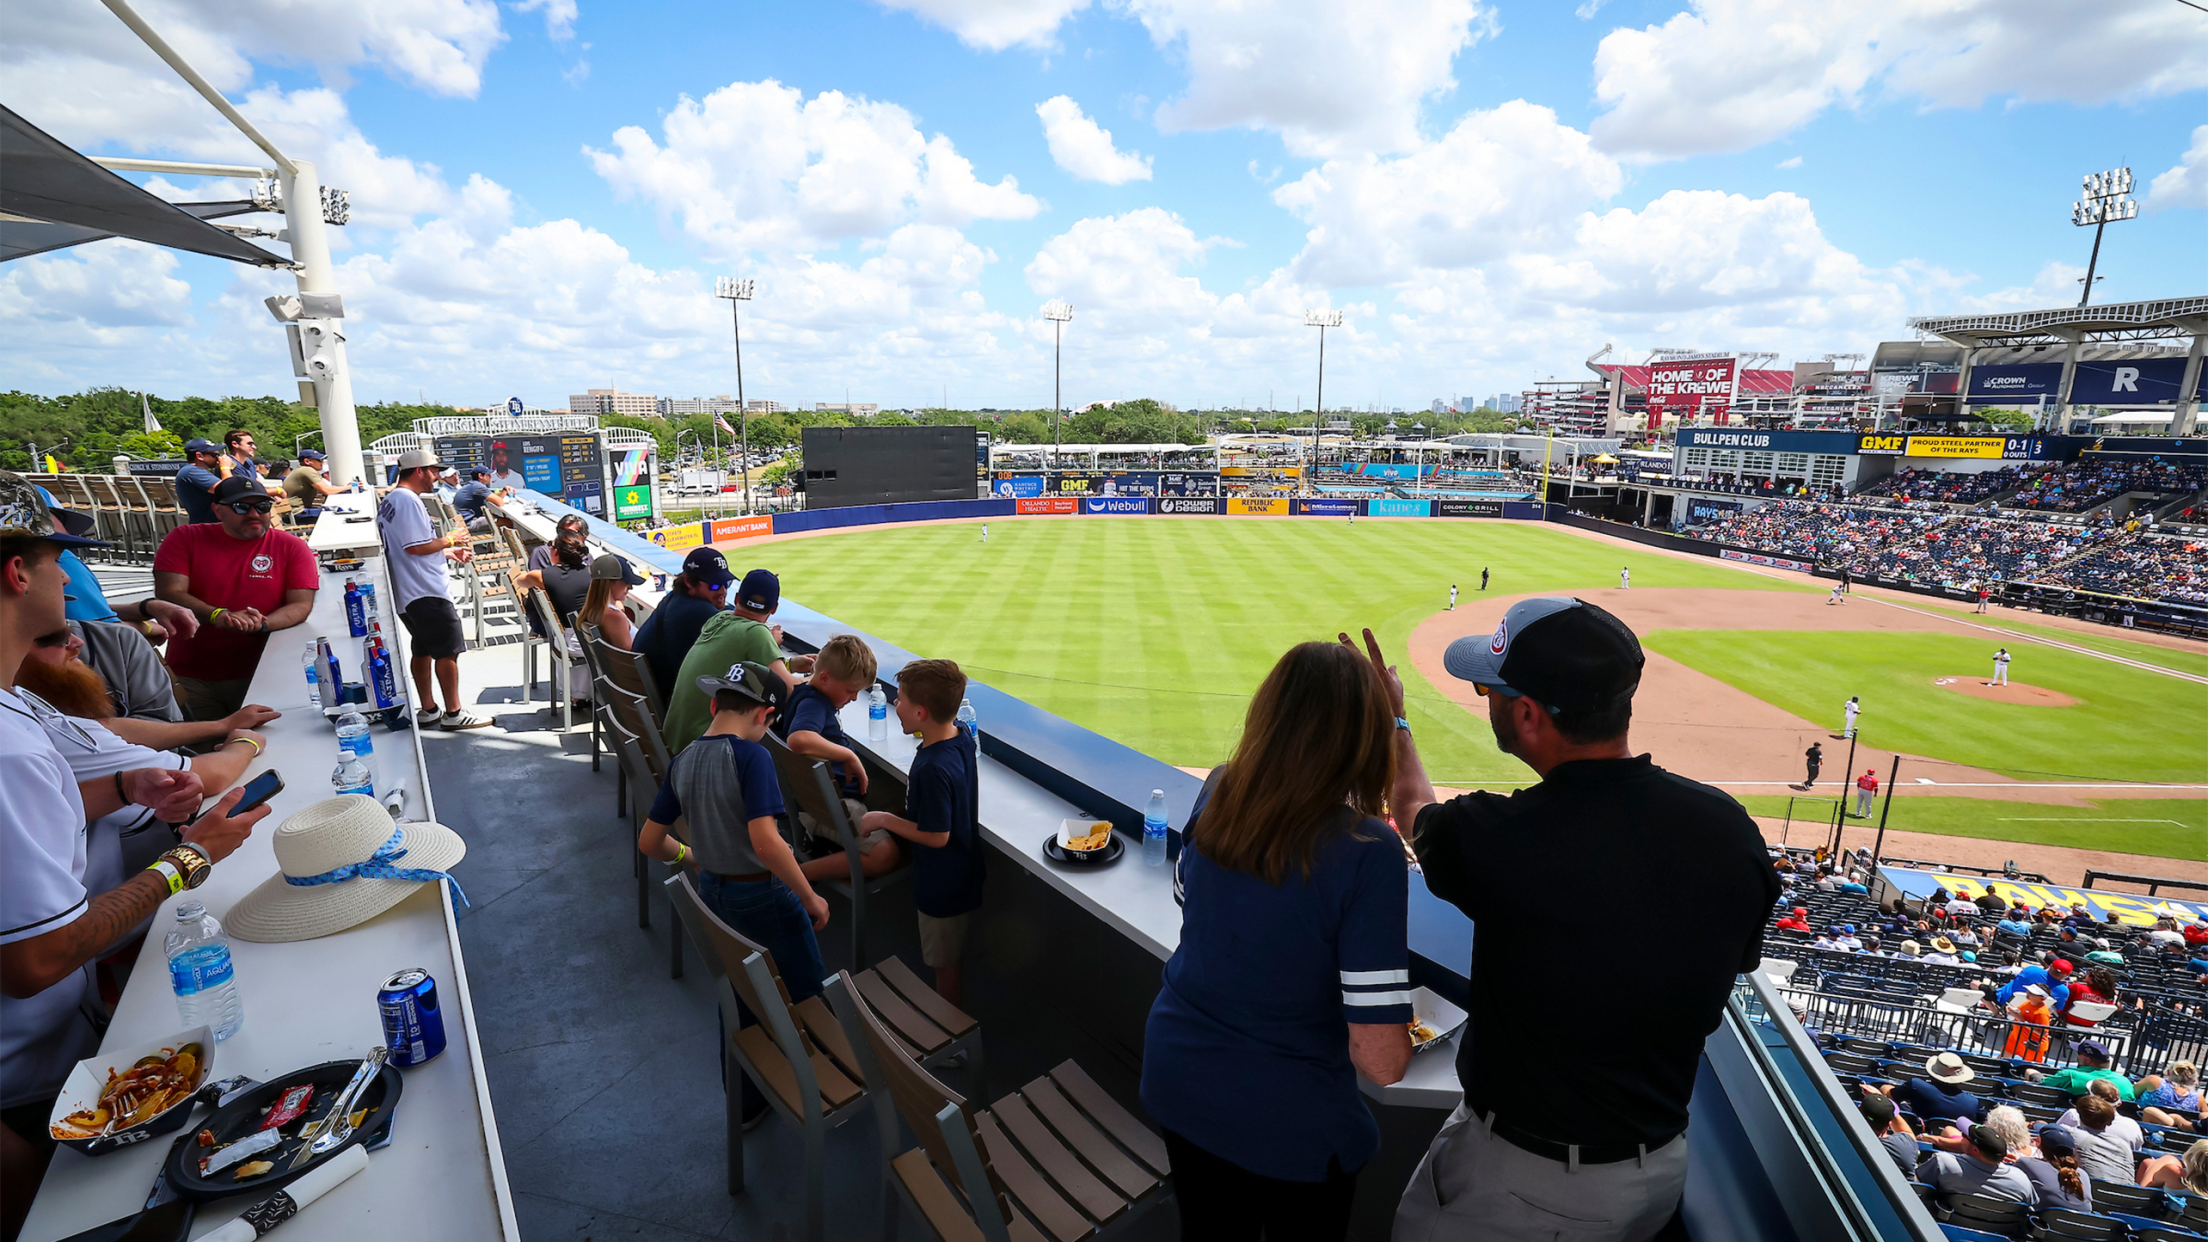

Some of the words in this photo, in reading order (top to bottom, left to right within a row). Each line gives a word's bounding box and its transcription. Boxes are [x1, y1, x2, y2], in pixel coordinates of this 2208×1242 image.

[1651, 369, 1694, 383] HOME
[1705, 368, 1728, 381] OF
[1880, 374, 1920, 382] KREWE
[1991, 376, 2027, 385] CROWN
[2112, 366, 2140, 392] R
[1648, 382, 1676, 395] THE
[1677, 381, 1732, 394] KREWE
[429, 420, 474, 433] GEORGE
[1693, 432, 1740, 446] BULLPEN
[1741, 434, 1770, 447] CLUB
[1861, 436, 1905, 450] GMF
[2007, 439, 2027, 451] 0-1
[523, 445, 545, 453] RENGIFO
[2009, 451, 2028, 459] OUTS
[2033, 443, 2042, 455] 3
[613, 460, 648, 476] VIVA
[1641, 460, 1668, 469] RLANDO
[1060, 480, 1089, 492] GMF
[1108, 500, 1146, 511] Webull
[1380, 501, 1421, 512] kane's
[1693, 506, 1719, 519] RAYS
[716, 523, 750, 536] AMERANT
[750, 521, 769, 531] BANK
[714, 556, 728, 570] TB
[1877, 576, 1898, 584] Spectrum
[1909, 582, 1932, 590] Spectrum
[1944, 588, 1967, 596] Spectrum
[351, 602, 361, 626] ULTRA
[723, 662, 745, 682] TB
[104, 1130, 151, 1147] TB
